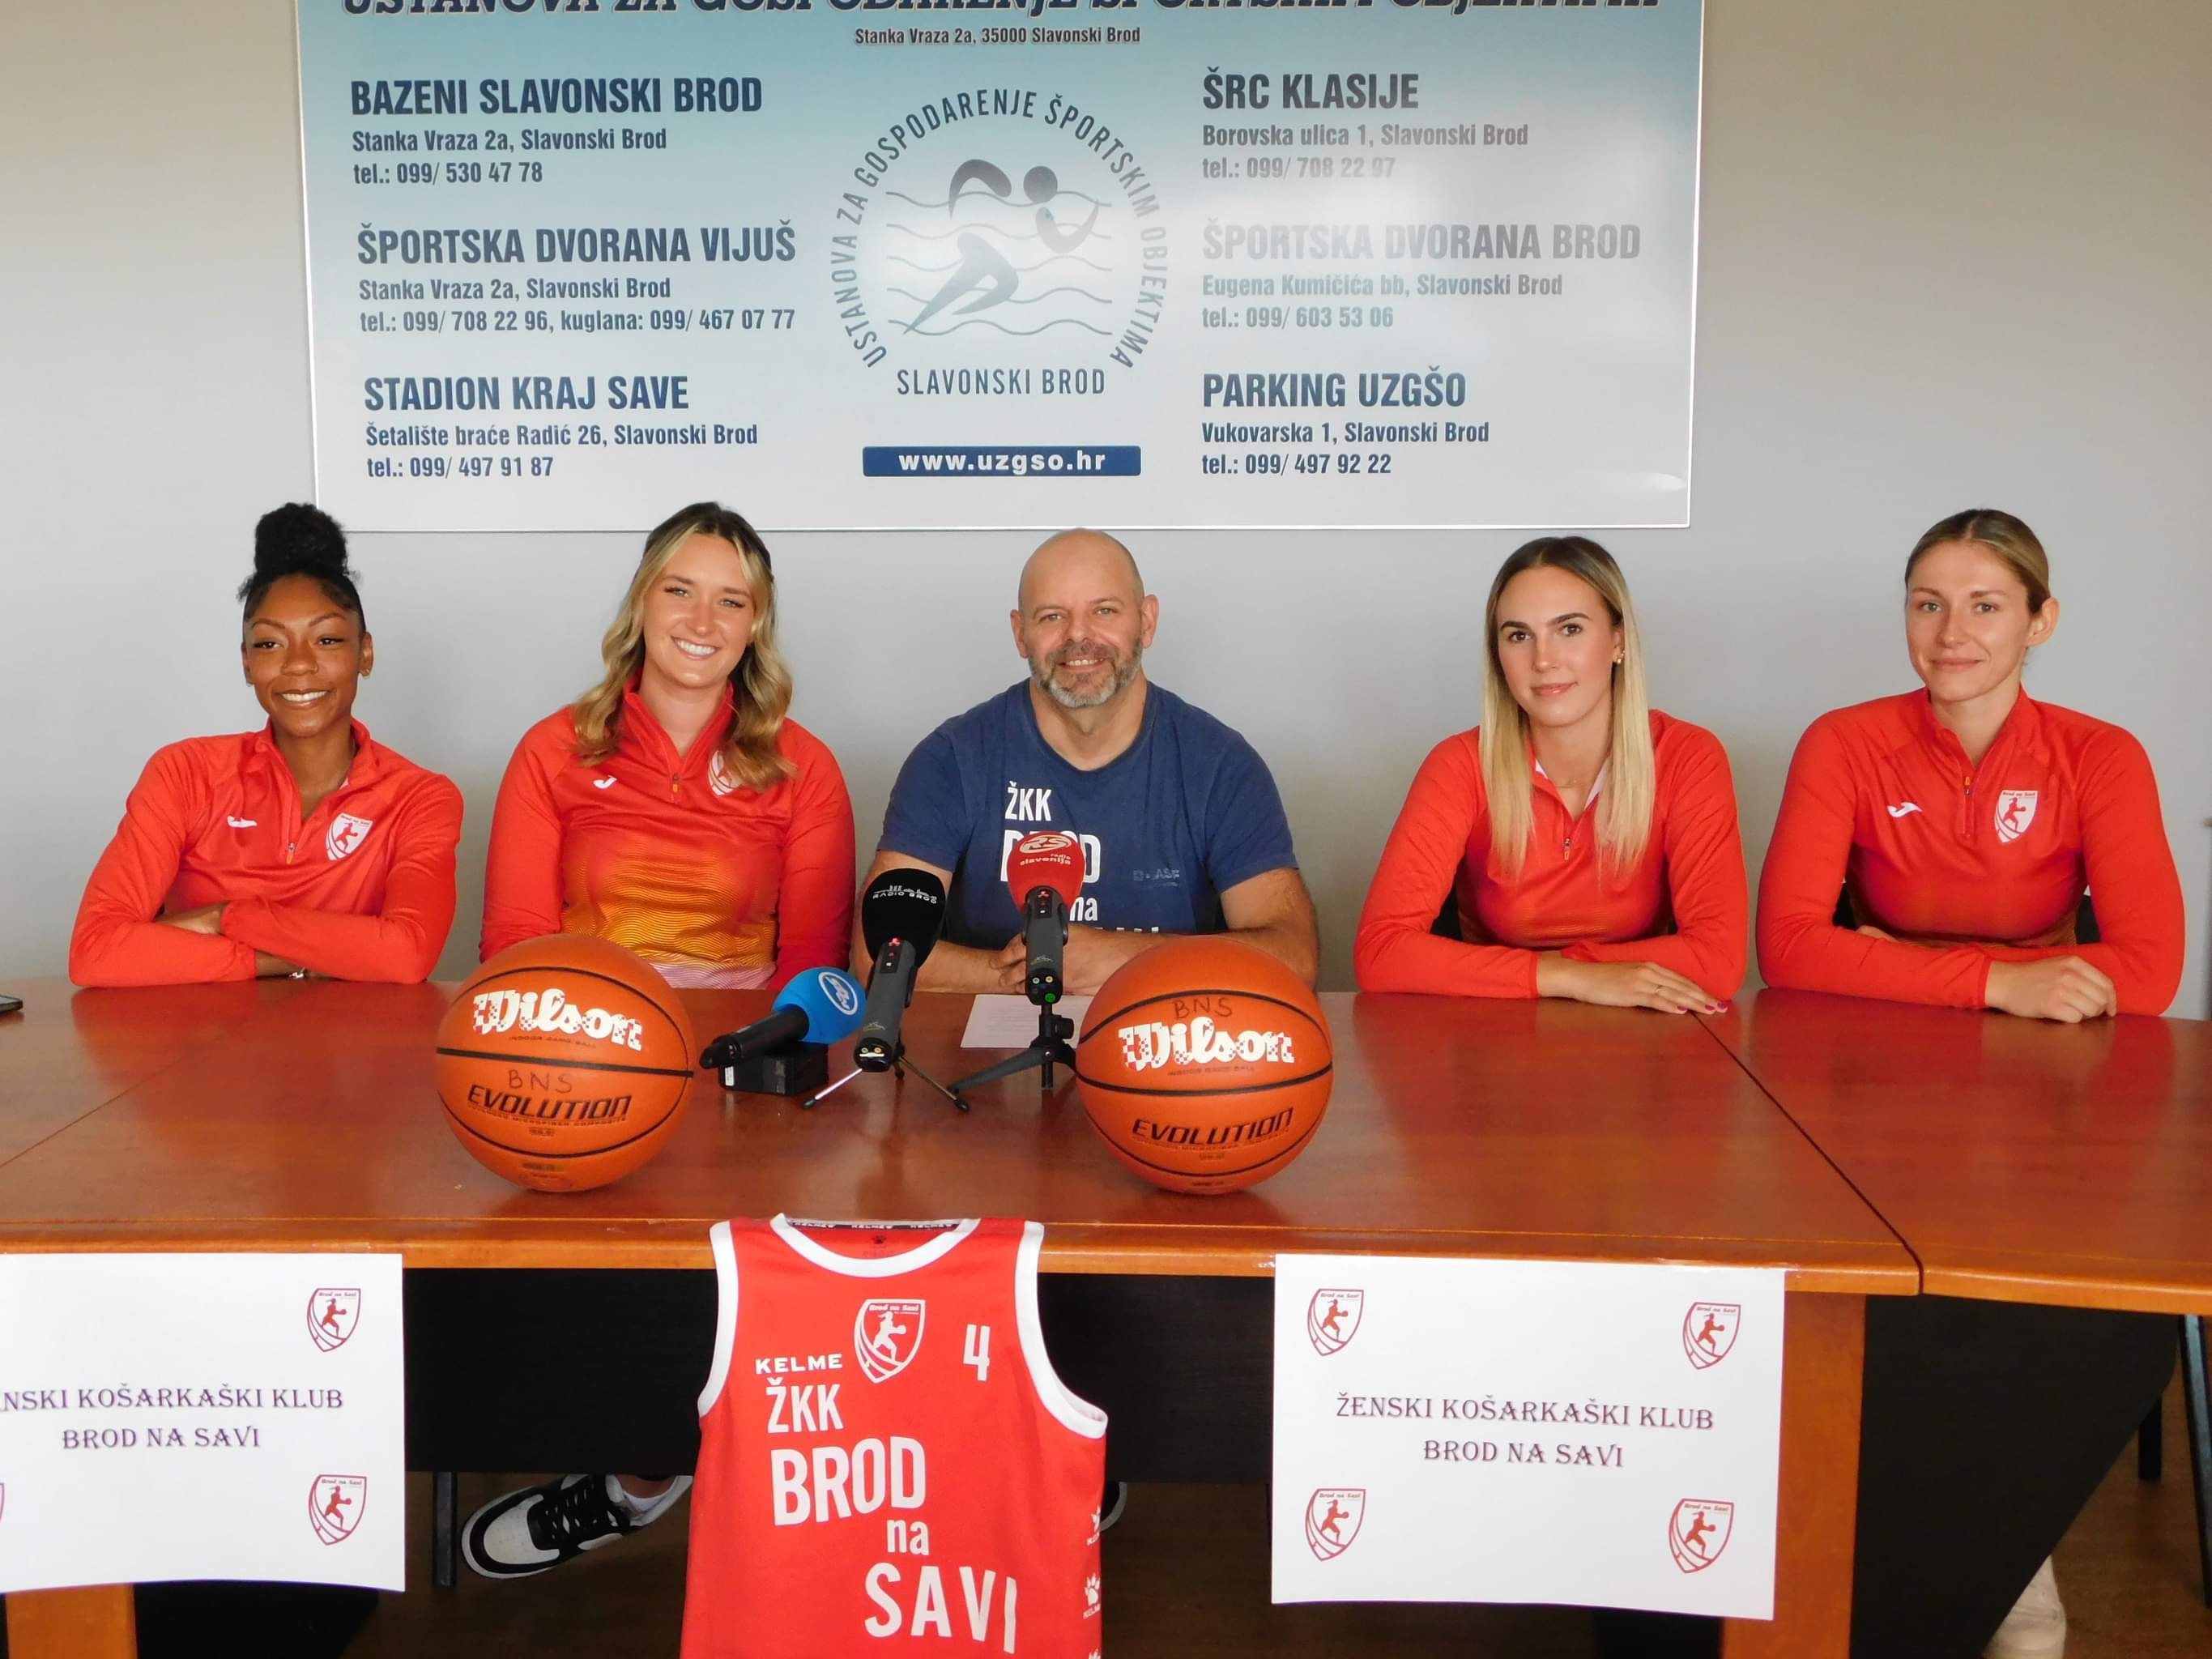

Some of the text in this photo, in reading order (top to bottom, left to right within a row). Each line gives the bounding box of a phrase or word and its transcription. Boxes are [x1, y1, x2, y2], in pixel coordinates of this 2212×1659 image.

[855, 27, 1140, 45] Stanka Vraza 2a, 35000 Slavonski Brod
[351, 77, 762, 115] BAZENI SLAVONSKI BROD
[1203, 66, 1419, 109] ŠRC KLASIJE
[352, 128, 666, 153] Stanka Vraza 2a, Slavonski Brod
[1203, 124, 1528, 147] Borovska ulica 1, Slavonski Brod
[353, 162, 543, 186] tel.: 099/ 530 47 78
[1203, 158, 1240, 179] tel.:
[1247, 157, 1291, 180] 099/
[1297, 156, 1334, 178] 708
[1340, 156, 1365, 178] 22
[830, 88, 1168, 369] USTANOVA ZA GOSPODARENJE ŠPORTSKIM OBJEKTIMA
[1203, 217, 1640, 260] ŠPORTSKA DVORANA BROD
[358, 219, 795, 264] ŠPORTSKA DVORANA VIJUŠ
[360, 277, 671, 301] Stanka Vraza 2a, Slavonski Brod
[1203, 274, 1562, 298] Eugena Kumičića bb, Slavonski Brod
[360, 309, 795, 334] tel.: 099/ 708 22 96, kuglana: 099/ 467 07 77
[1202, 306, 1393, 329] tel.: 099/ 603 53 06
[364, 376, 688, 410] STADION KRAJ SAVE
[897, 369, 1105, 394] SLAVONSKI BROD
[1203, 365, 1466, 407] PARKING UZGŠO
[366, 421, 757, 447] Šetalište braće Radić 26, Slavonski Brod
[1202, 422, 1489, 445] Vukovarska 1, Slavonski Brod
[367, 457, 553, 478] tel.: 099/ 497 91 87
[898, 450, 1106, 475] www.uzgso.hr
[1202, 454, 1392, 476] tel.: 099/ 497 92 22
[1004, 781, 1052, 822] ŽKK
[1020, 856, 1071, 865] slavonija
[872, 891, 937, 904] RADIO BROD
[1069, 897, 1098, 921] na
[473, 987, 642, 1051] Wilson
[1172, 997, 1233, 1019] BNS
[1119, 1016, 1294, 1072] Wilson
[508, 1070, 573, 1094] BNS
[467, 1085, 632, 1120] EVOLUTION
[1132, 1107, 1294, 1145] EVOLUTION
[755, 1354, 842, 1375] KELME
[963, 1324, 990, 1380] 4
[0, 1383, 343, 1411] NSKI KOŠARKAŠKI KLUB
[766, 1377, 843, 1433] ŽKK
[1336, 1392, 1714, 1431] ŽENSKI KOŠARKAŠKI KLUB
[62, 1426, 261, 1449] BROD NA SAVI
[1423, 1439, 1624, 1468] BROD NA SAVI
[771, 1435, 926, 1526] BROD
[886, 1519, 929, 1555] na
[864, 1562, 1016, 1654] SAVI
